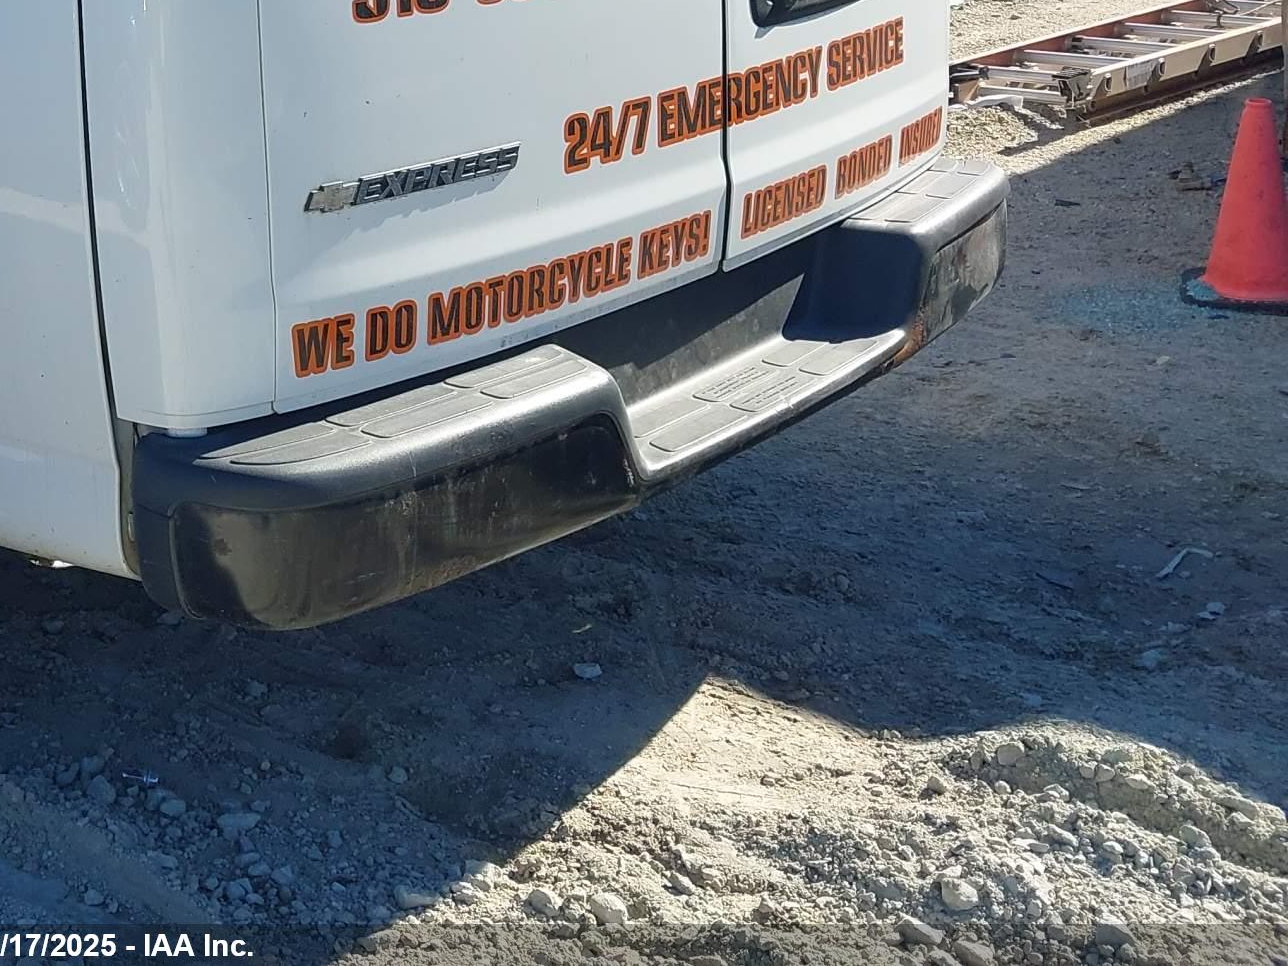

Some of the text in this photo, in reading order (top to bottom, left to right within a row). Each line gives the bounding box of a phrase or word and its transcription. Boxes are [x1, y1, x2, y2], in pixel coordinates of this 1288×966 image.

[564, 16, 904, 175] 24/7 EMERGENCY SERVICE
[353, 140, 520, 205] EXPRESS
[740, 106, 943, 240] LICENSED BONDED INSURED
[291, 210, 712, 378] WE DO MOTORCYCLE KEYS!
